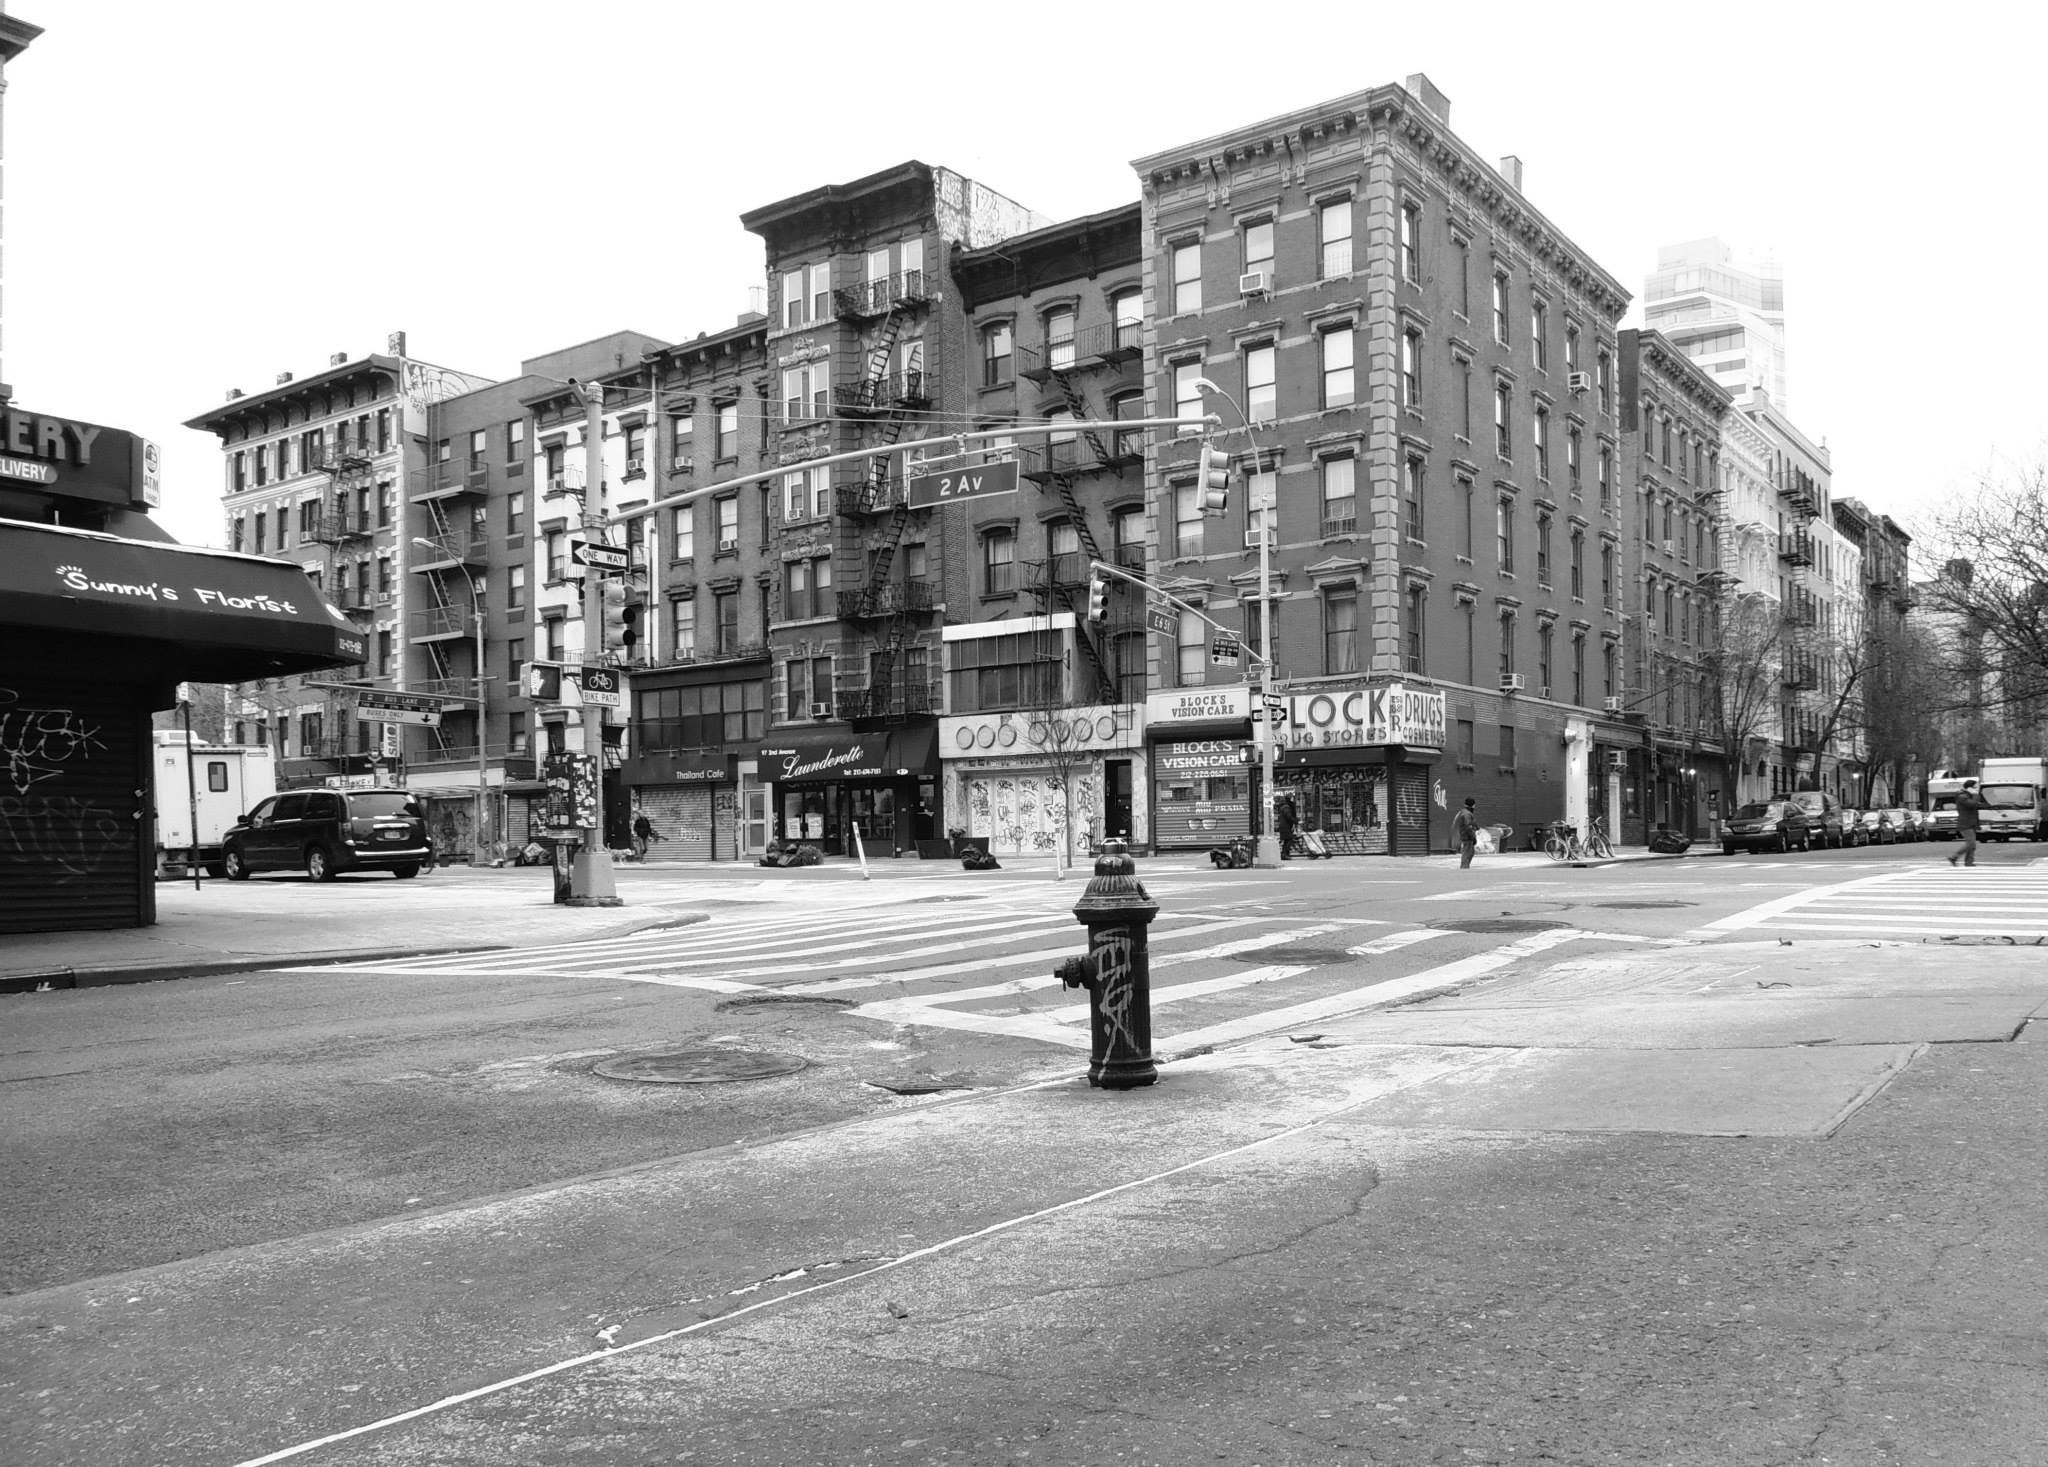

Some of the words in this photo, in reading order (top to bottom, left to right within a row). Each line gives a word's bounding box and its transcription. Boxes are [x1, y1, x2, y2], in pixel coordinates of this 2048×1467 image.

[0, 411, 100, 464] ERY
[0, 458, 48, 481] LIVERY
[144, 475, 159, 493] ATM
[940, 478, 951, 496] 2
[957, 475, 982, 493] Av
[583, 549, 598, 560] ONE
[606, 553, 624, 564] WAY
[63, 569, 179, 601] Sunny's
[193, 587, 298, 614] Florist
[584, 691, 600, 702] BIKE
[601, 693, 618, 705] PATH
[1180, 695, 1226, 706] BLOCK'S
[1172, 708, 1205, 718] VISION
[1207, 704, 1235, 716] CARE
[1272, 690, 1387, 730] LOCK
[1405, 693, 1443, 727] DRUGS
[1323, 727, 1387, 745] STORES
[1173, 741, 1232, 754] BLOCK'S
[780, 745, 864, 780] Launderette
[1162, 756, 1208, 768] VISION
[676, 770, 705, 779] Thailand
[707, 769, 725, 778] Cafe
